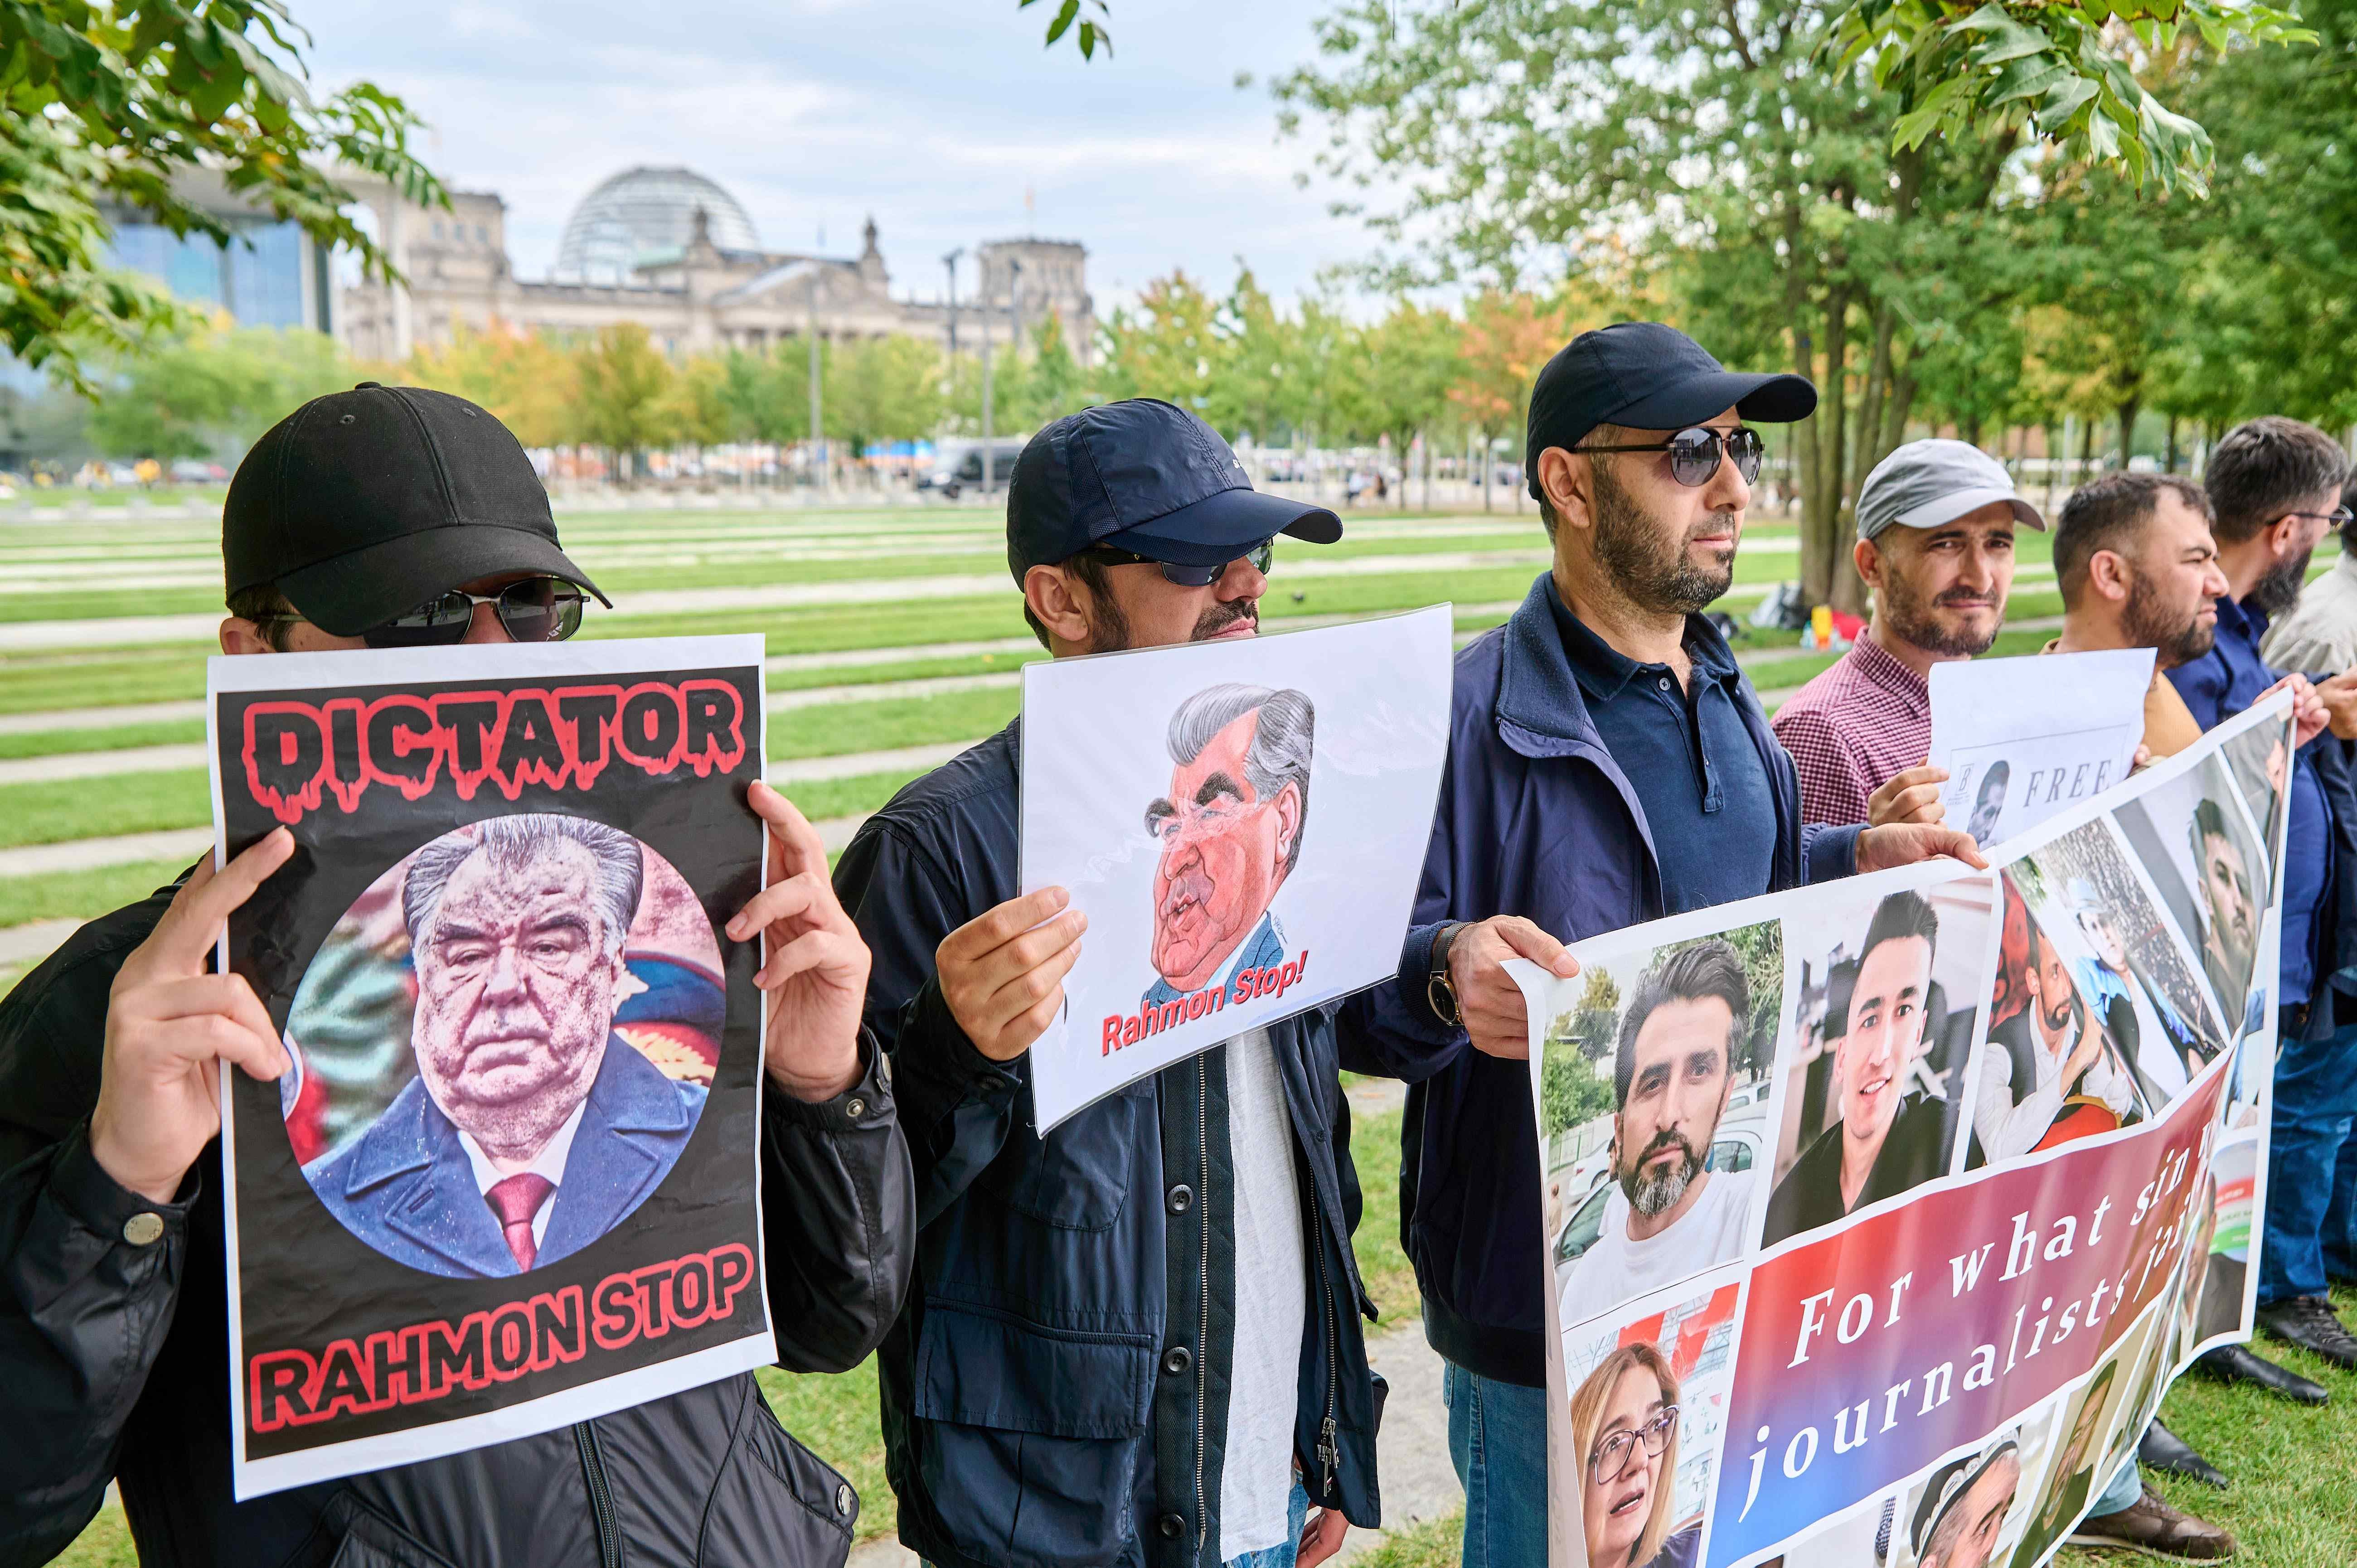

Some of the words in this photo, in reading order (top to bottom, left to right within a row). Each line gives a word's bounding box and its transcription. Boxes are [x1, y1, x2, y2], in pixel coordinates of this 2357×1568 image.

[242, 679, 746, 825] DICTATOR
[2023, 760, 2111, 807] FREE
[1102, 985, 1226, 1057] Rahmon
[1233, 950, 1309, 1005] Stop!
[250, 1285, 586, 1433] RAHMON
[592, 1244, 754, 1350] STOP
[1787, 1272, 1912, 1369] For
[1949, 1195, 2111, 1297] what
[2130, 1148, 2189, 1226] sin
[1739, 1269, 2130, 1523] journalists
